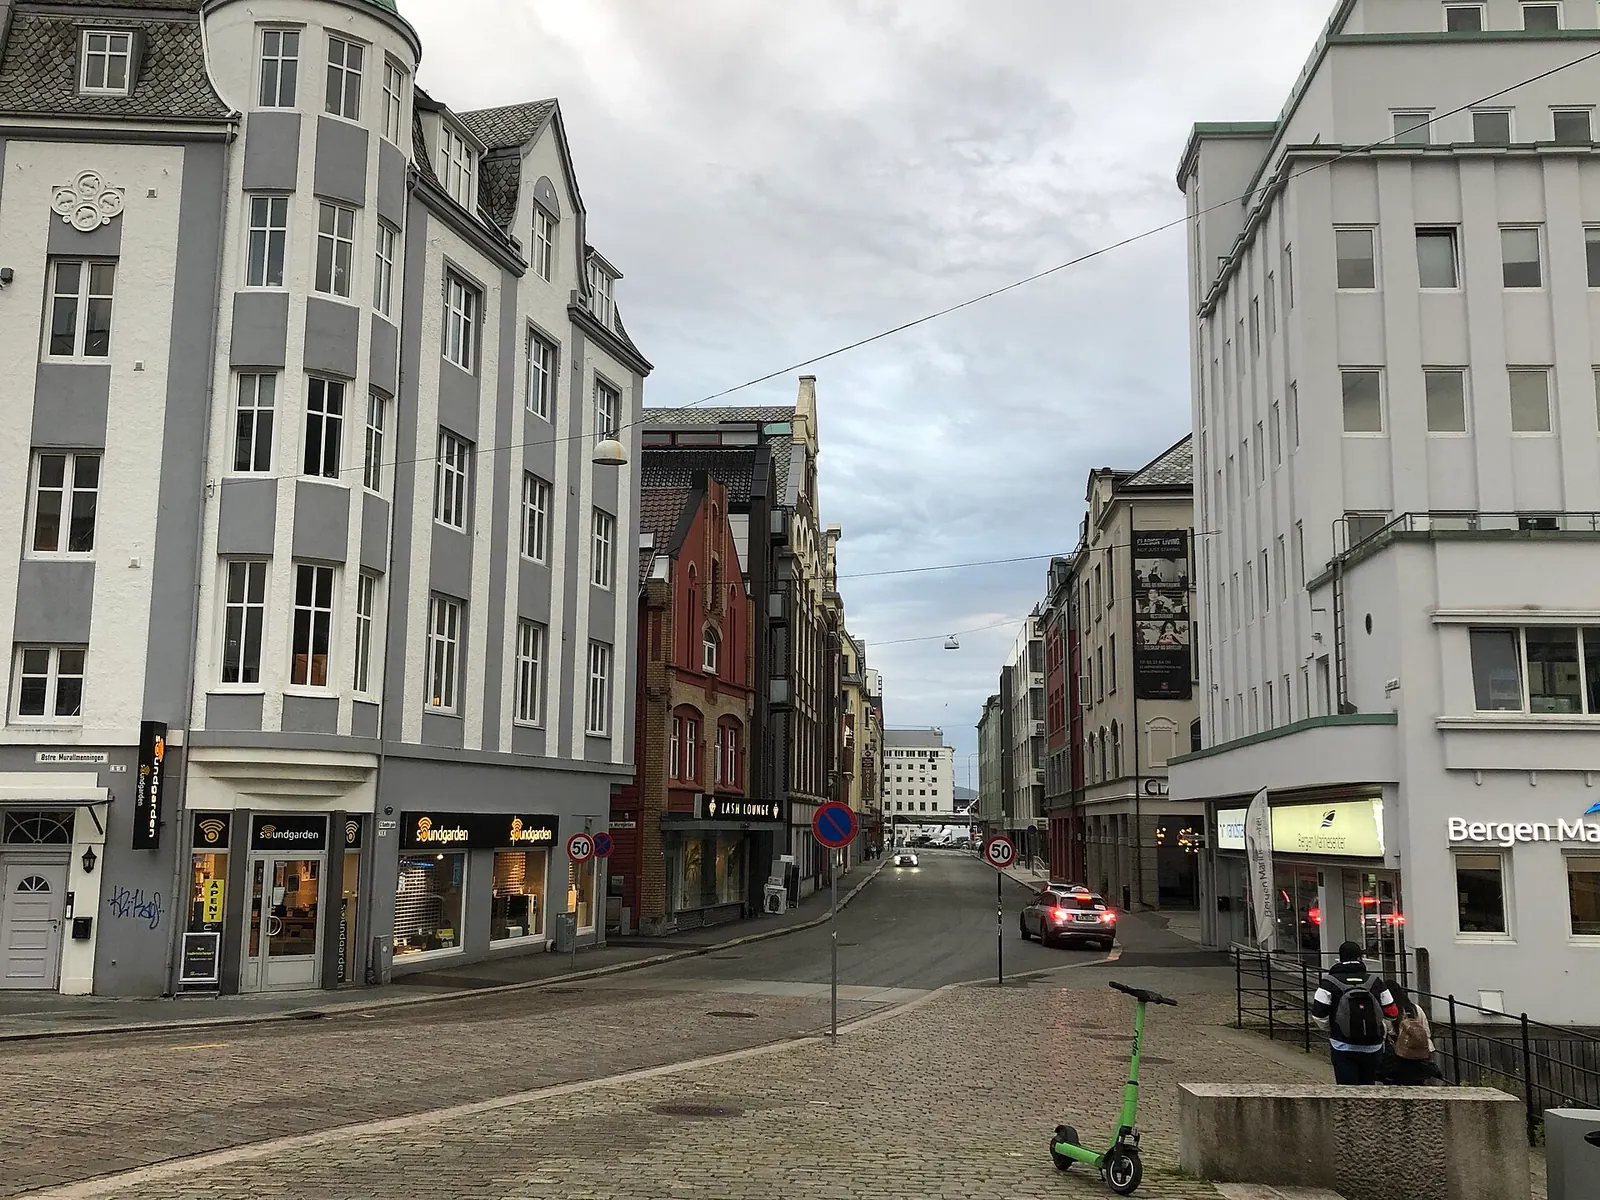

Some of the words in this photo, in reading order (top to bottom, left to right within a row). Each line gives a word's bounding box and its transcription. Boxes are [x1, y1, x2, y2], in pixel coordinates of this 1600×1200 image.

[149, 735, 164, 838] soundgarden
[721, 802, 740, 815] LASH
[743, 803, 769, 816] LOUNGE
[259, 827, 319, 841] soundgarden
[416, 819, 469, 844] soundgarden
[510, 820, 552, 843] soundgarden
[1448, 817, 1550, 848] Bergen
[572, 841, 590, 856] 50
[991, 843, 1011, 860] 50
